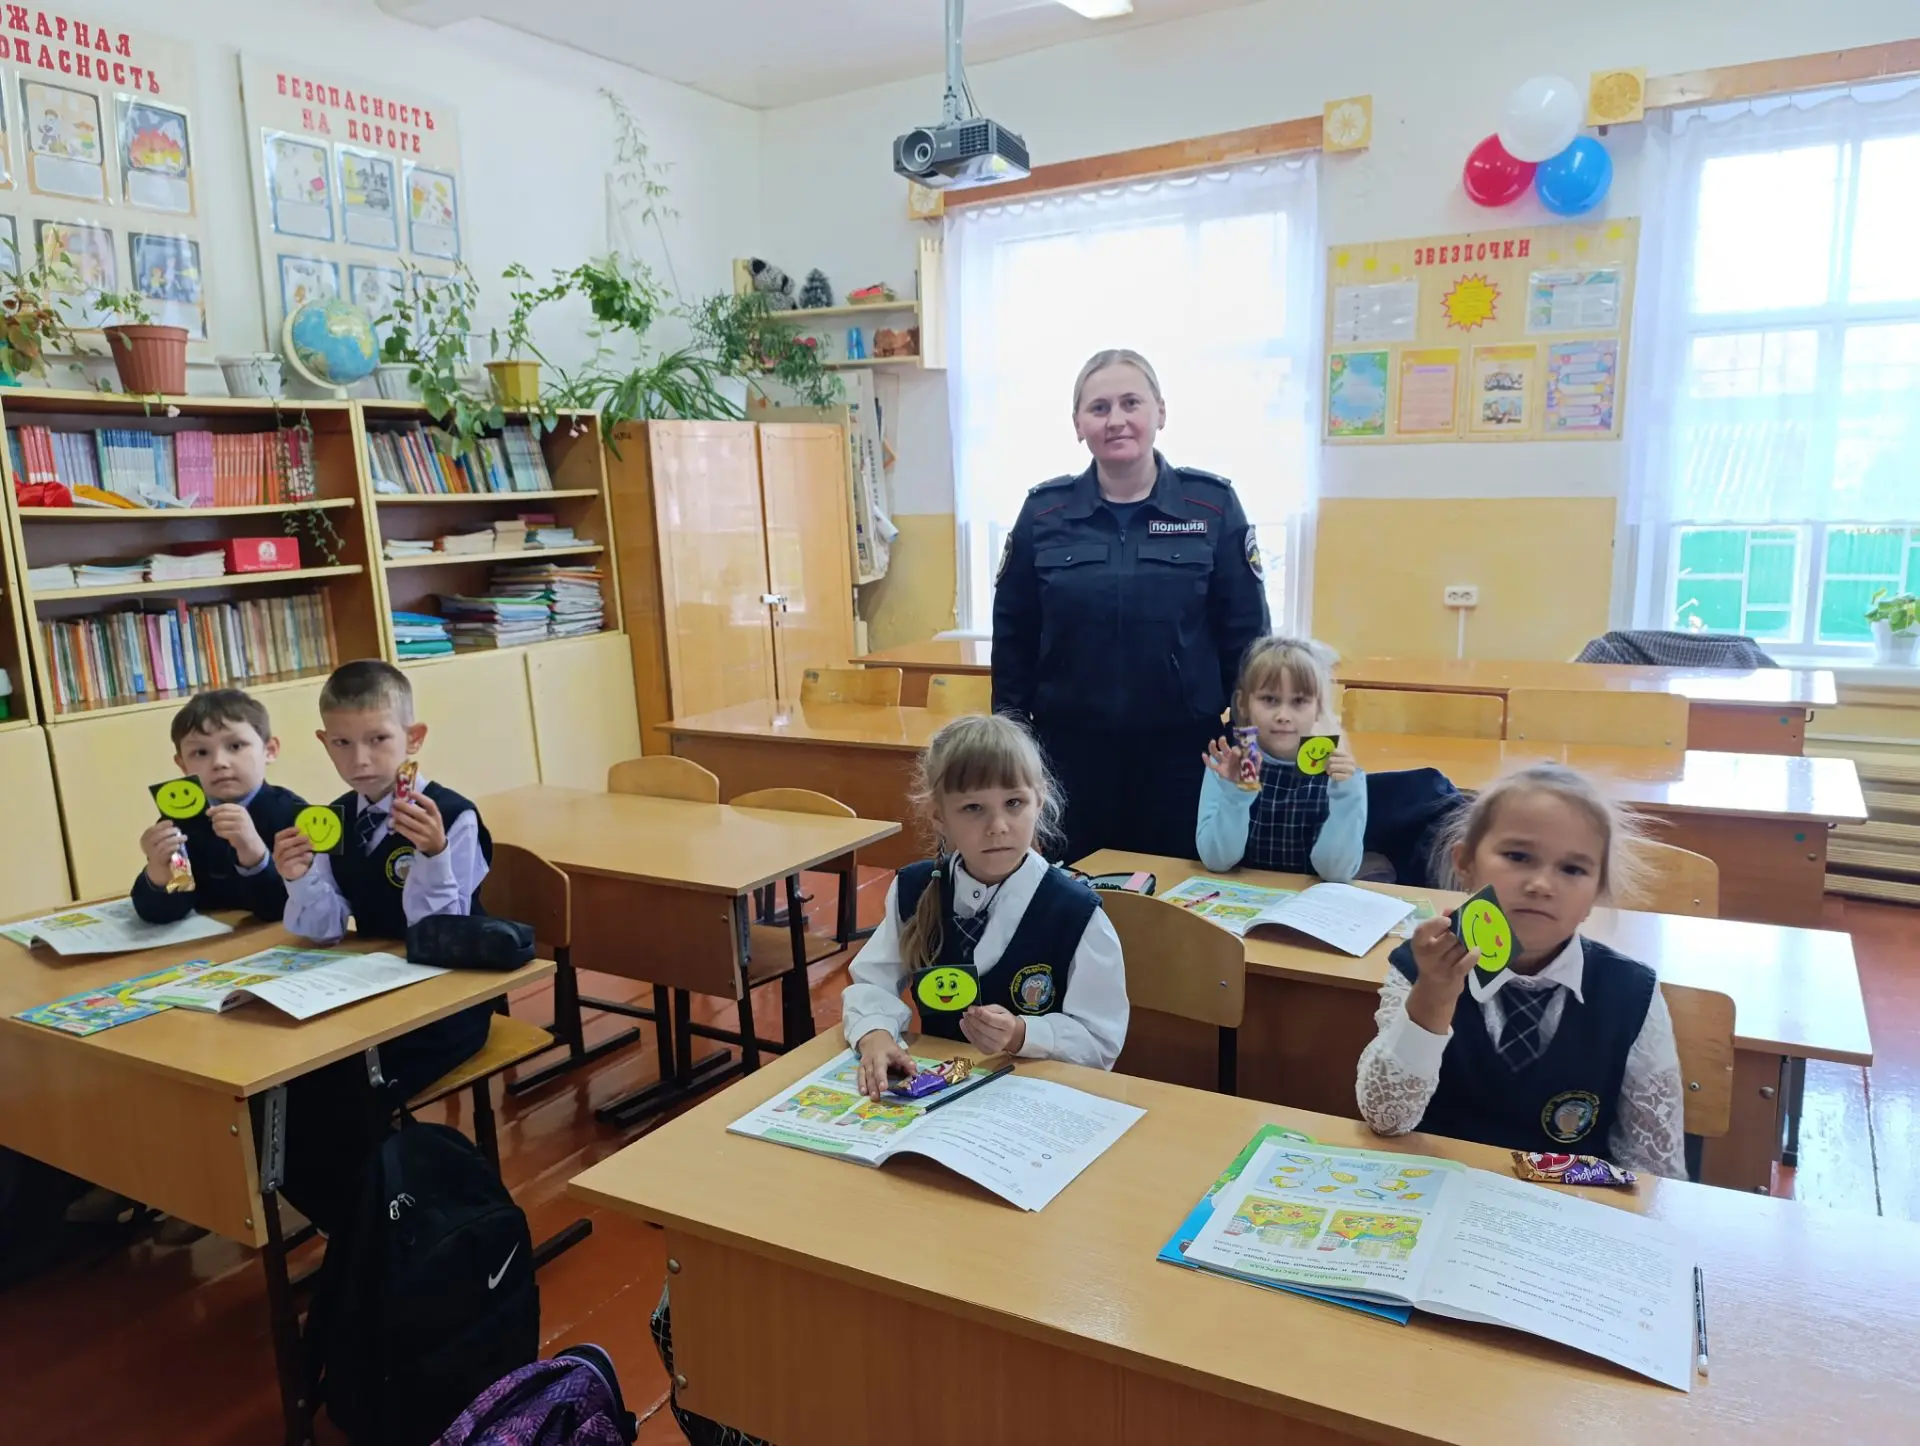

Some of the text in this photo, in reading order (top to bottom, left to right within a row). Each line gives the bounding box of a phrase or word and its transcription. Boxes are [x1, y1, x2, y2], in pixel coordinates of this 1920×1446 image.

[0, 4, 131, 57] ЖАРНАЯ
[277, 74, 434, 130] БЕЗОПАСНОСТЬ
[302, 108, 421, 153] НА ПОРОГЕ
[1152, 522, 1204, 532] ПОЛИЦИЯ
